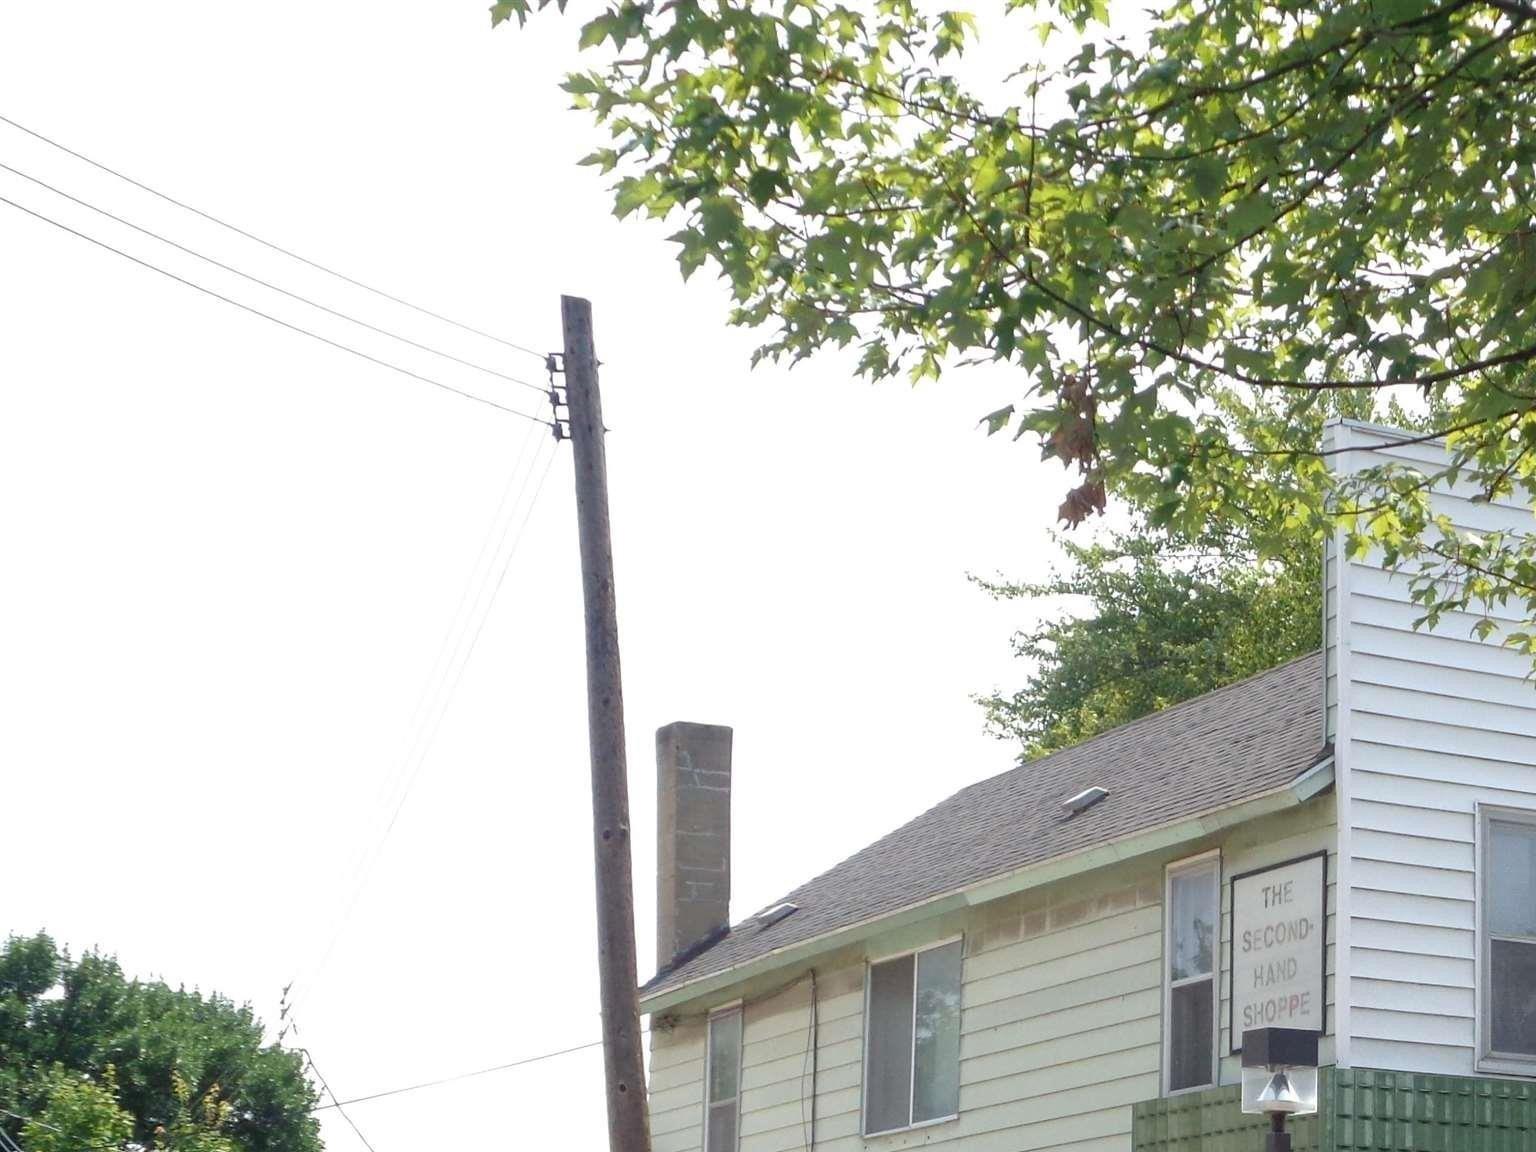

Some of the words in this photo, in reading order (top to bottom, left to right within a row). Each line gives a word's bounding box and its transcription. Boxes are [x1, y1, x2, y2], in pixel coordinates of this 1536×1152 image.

[1262, 880, 1293, 909] THE
[1253, 957, 1298, 989] HAND
[1243, 991, 1311, 1028] SHOPPE
